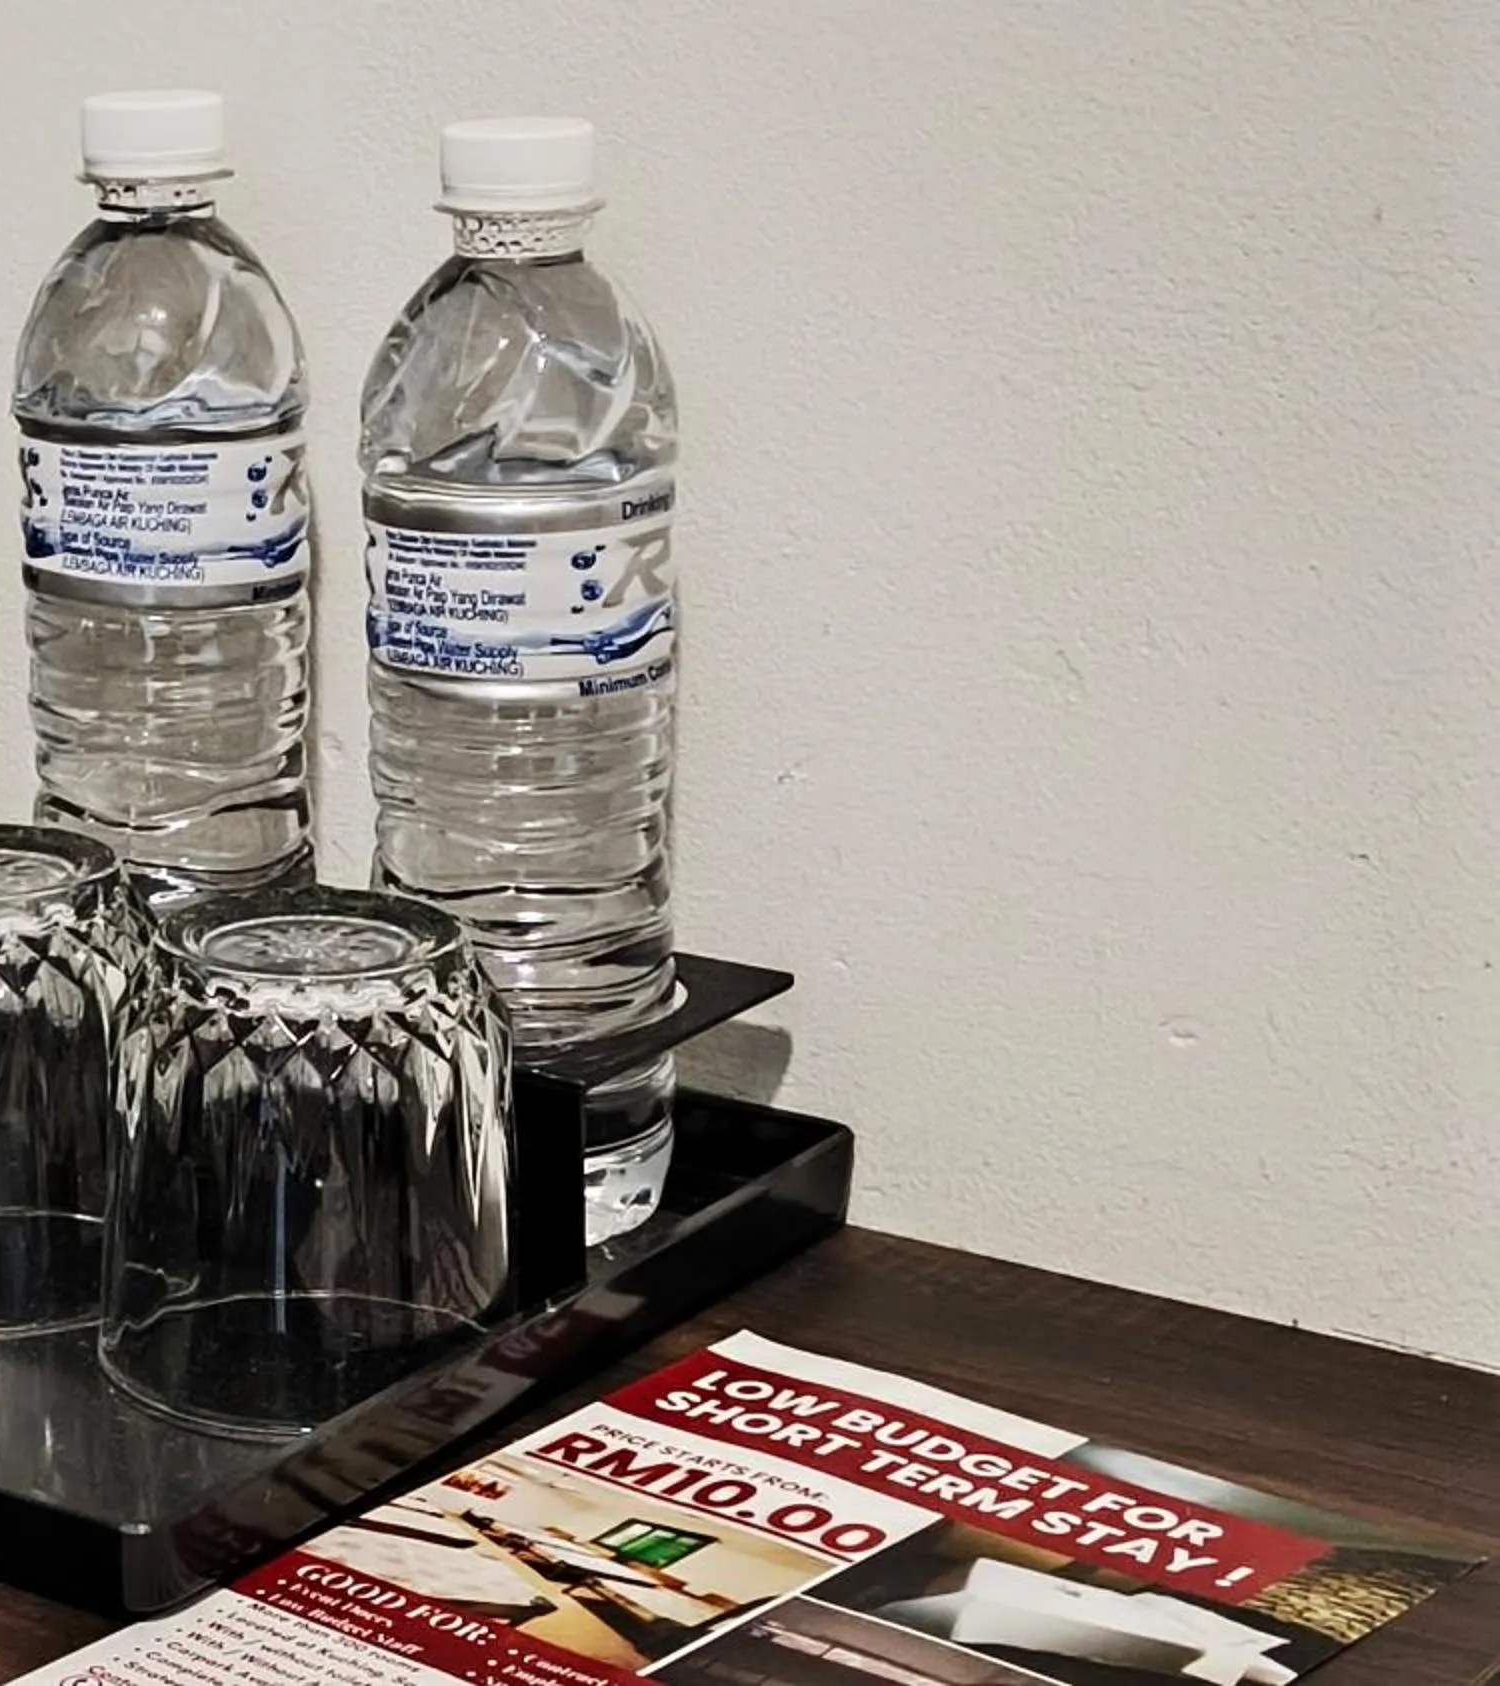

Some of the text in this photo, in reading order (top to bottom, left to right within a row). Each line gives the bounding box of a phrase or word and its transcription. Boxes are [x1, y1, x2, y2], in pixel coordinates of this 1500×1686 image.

[138, 502, 164, 517] Yang
[94, 531, 131, 549] Source
[416, 621, 447, 638] Source
[475, 642, 518, 662] Supply
[579, 672, 647, 697] Minimum
[589, 1424, 654, 1450] PRICE
[658, 1445, 748, 1476] STARTS
[692, 1371, 1224, 1546] LOW BUDGET FOR
[537, 1431, 887, 1553] RM10.00
[655, 1391, 861, 1455] SHORT
[860, 1449, 1034, 1519] TERM
[1032, 1511, 1218, 1573] STAY
[296, 1564, 497, 1645] GOOD FOR:
[209, 1621, 244, 1641] With
[227, 1612, 298, 1642] Located
[268, 1594, 425, 1655] Low Budget Staff
[188, 1631, 224, 1650] With
[167, 1641, 234, 1673] Carpark
